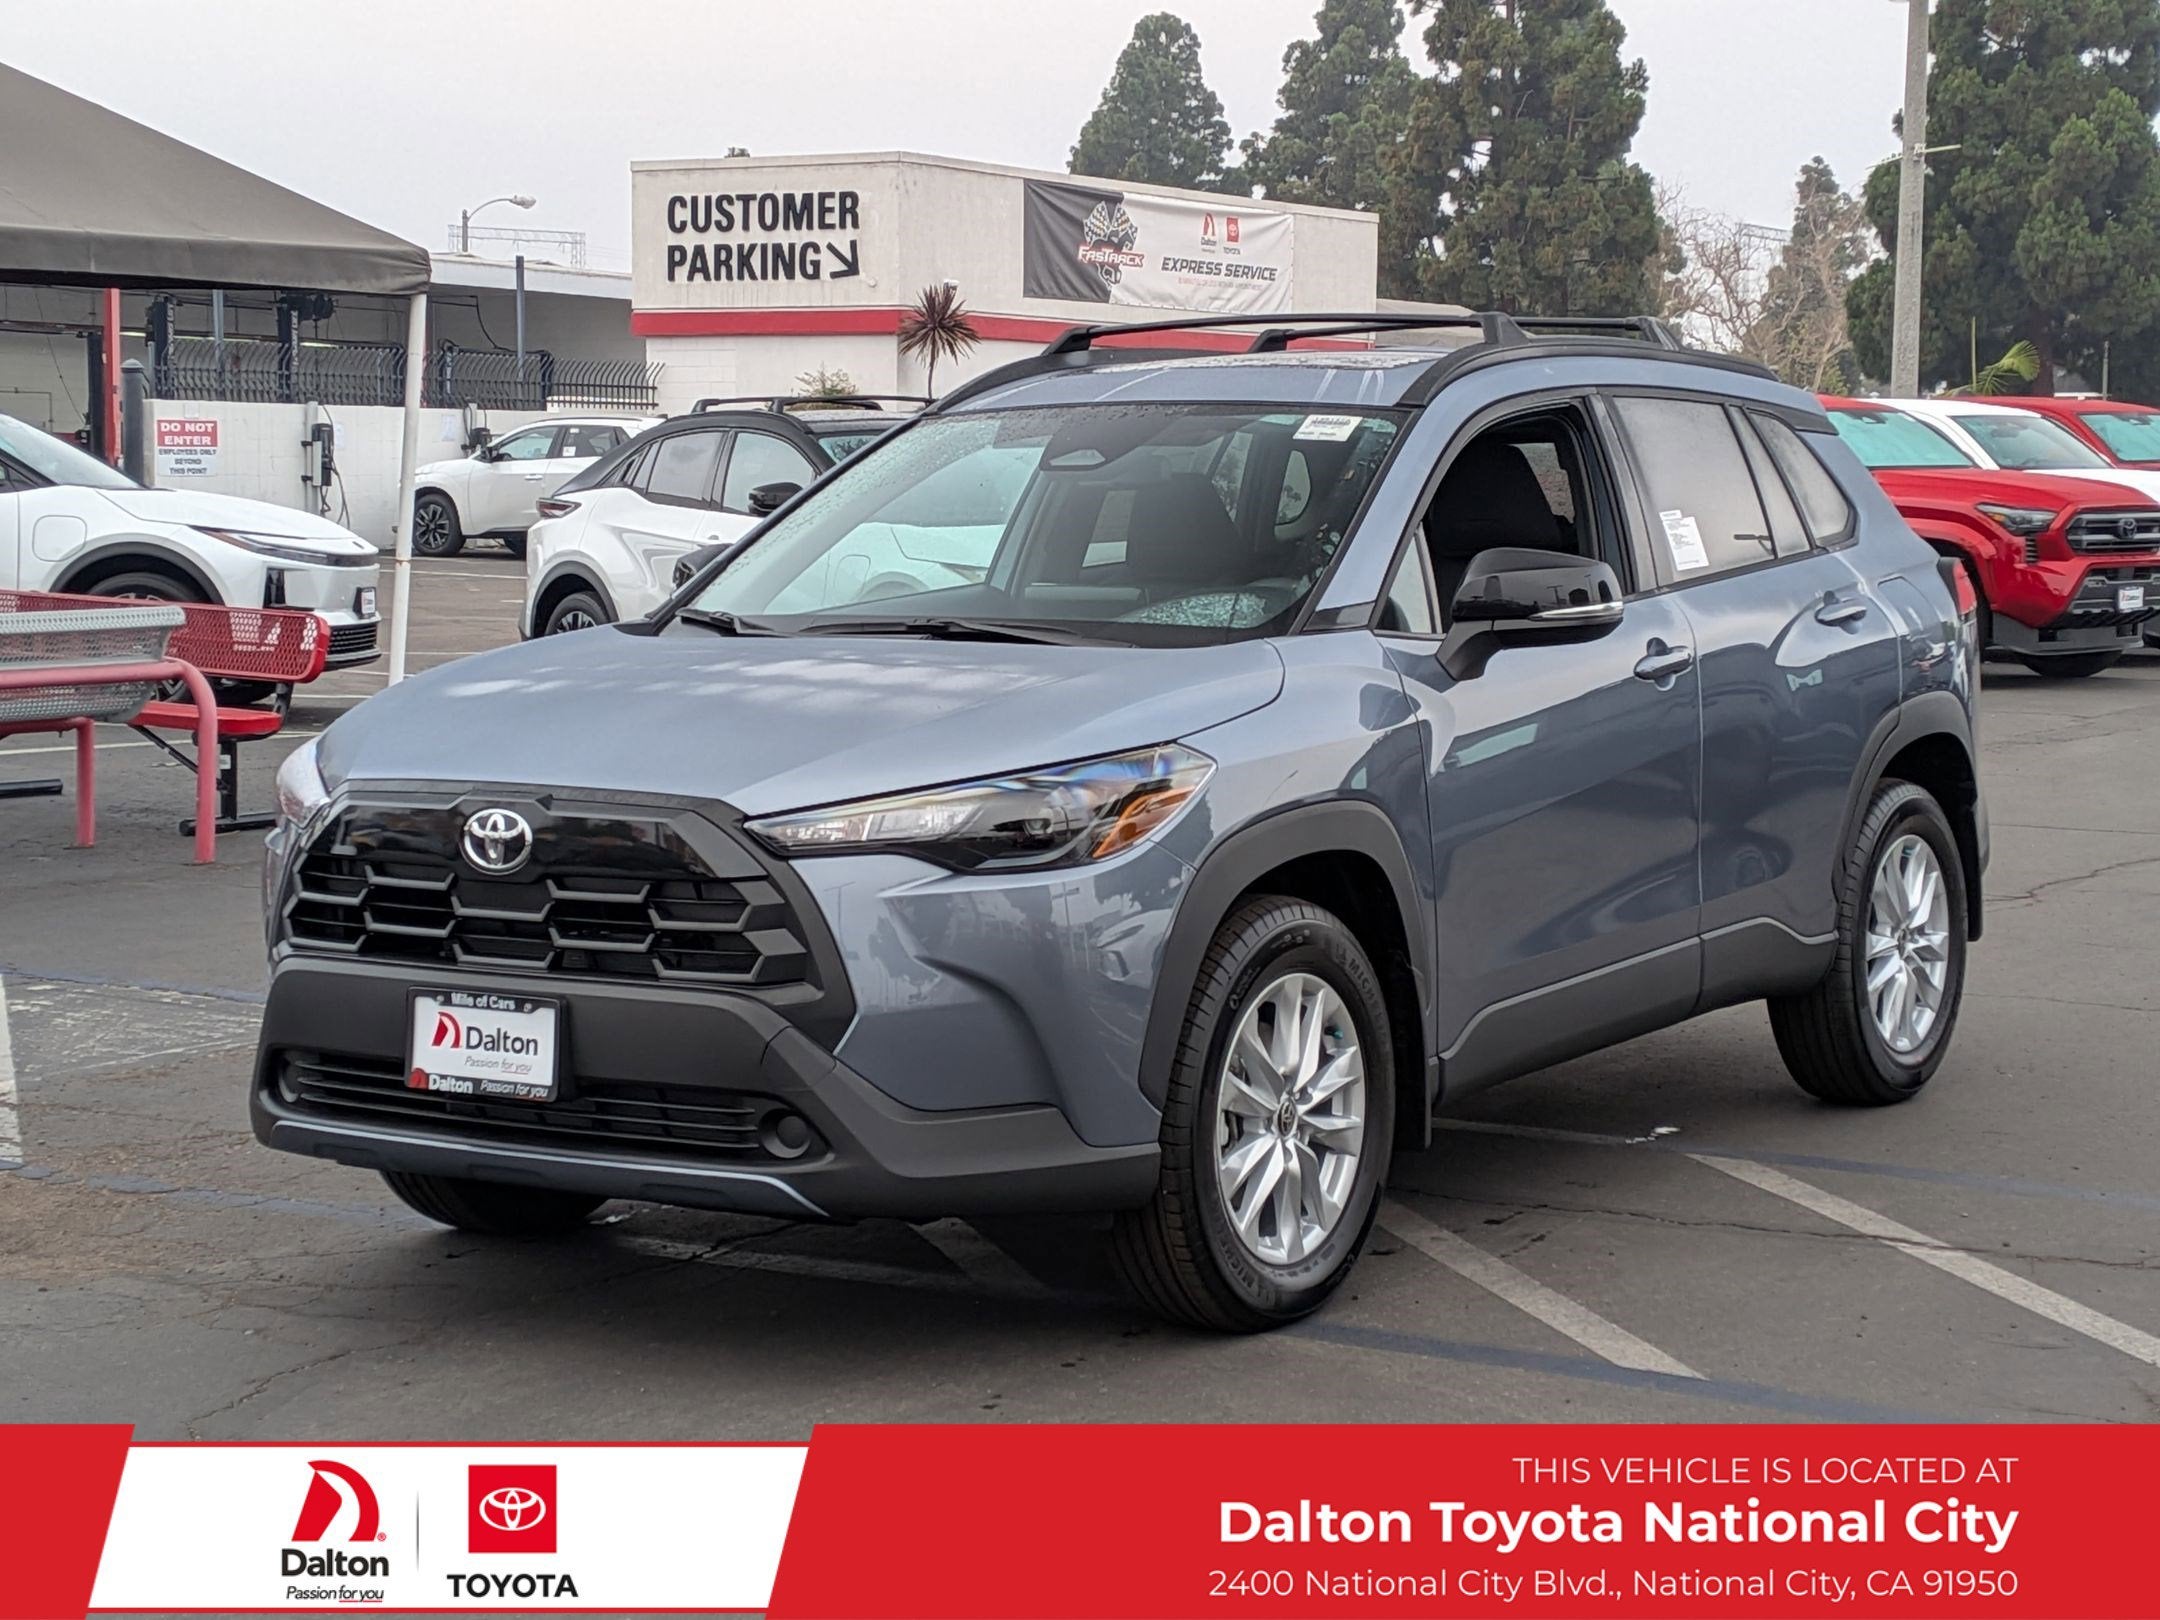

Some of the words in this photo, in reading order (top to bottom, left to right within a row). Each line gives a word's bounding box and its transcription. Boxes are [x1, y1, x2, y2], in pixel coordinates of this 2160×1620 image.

[667, 191, 860, 234] CUSTOMER
[667, 242, 821, 282] PARKING
[1161, 257, 1223, 277] EXPRESS
[1224, 263, 1278, 282] SERVICE
[160, 422, 181, 432] DO
[184, 422, 215, 433] NOT
[164, 435, 211, 446] ENTER
[199, 448, 217, 456] ONLY
[169, 467, 186, 475] THIS
[186, 467, 208, 475] POINT
[451, 992, 474, 1006] Mile
[475, 995, 488, 1008] of
[489, 997, 516, 1011] Cars
[465, 1026, 538, 1056] Dalton
[464, 1056, 500, 1070] Passion
[501, 1058, 515, 1072] for
[514, 1062, 533, 1075] you
[428, 1075, 474, 1095] Dalton
[480, 1080, 515, 1094] Passion
[515, 1083, 530, 1097] for
[530, 1086, 549, 1099] you
